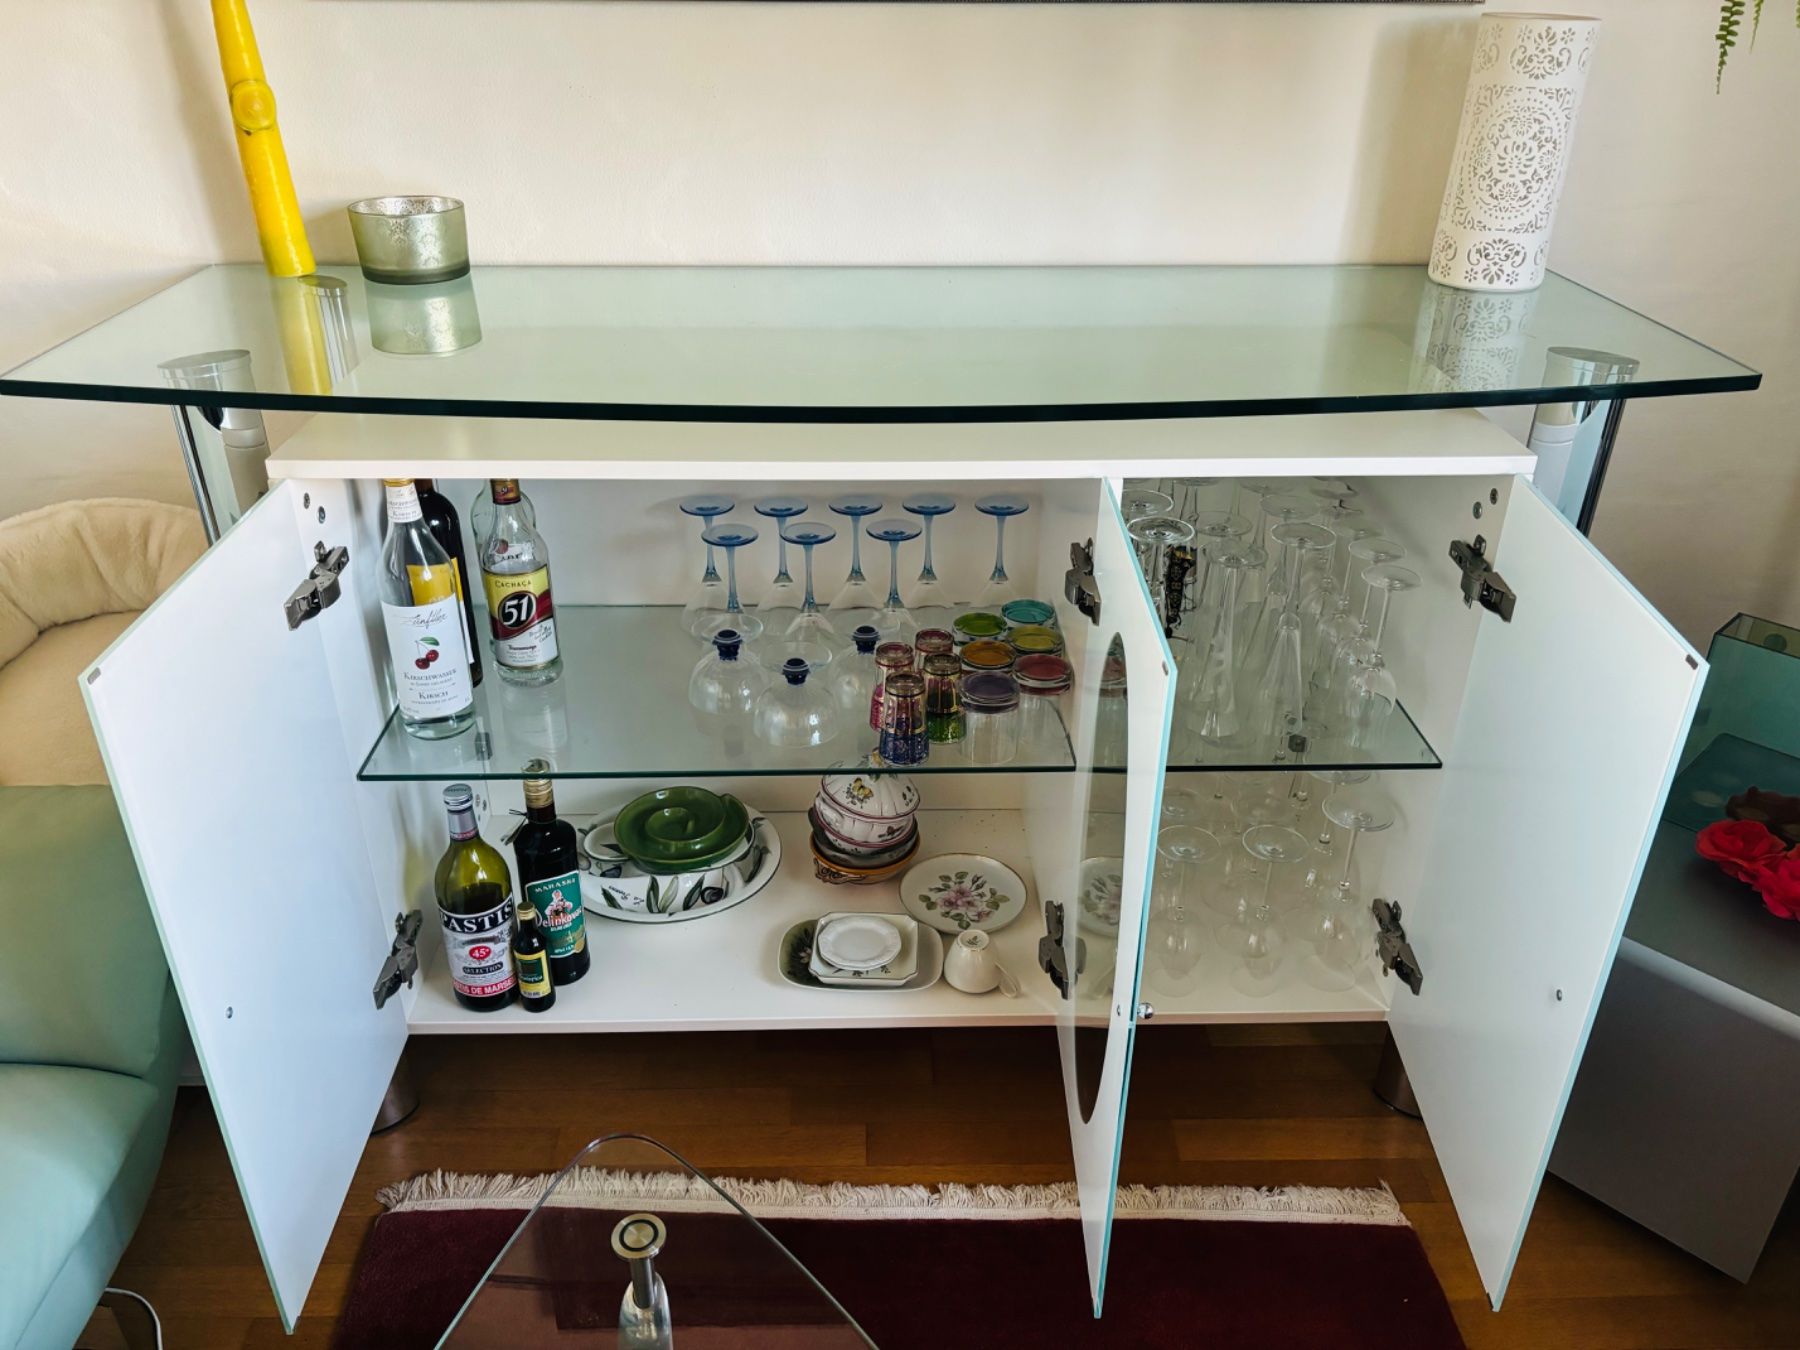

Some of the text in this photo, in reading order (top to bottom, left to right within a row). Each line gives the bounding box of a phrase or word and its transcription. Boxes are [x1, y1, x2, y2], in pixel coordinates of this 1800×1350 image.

[503, 595, 529, 626] 51
[441, 900, 513, 933] PASTIS
[471, 986, 483, 995] DE
